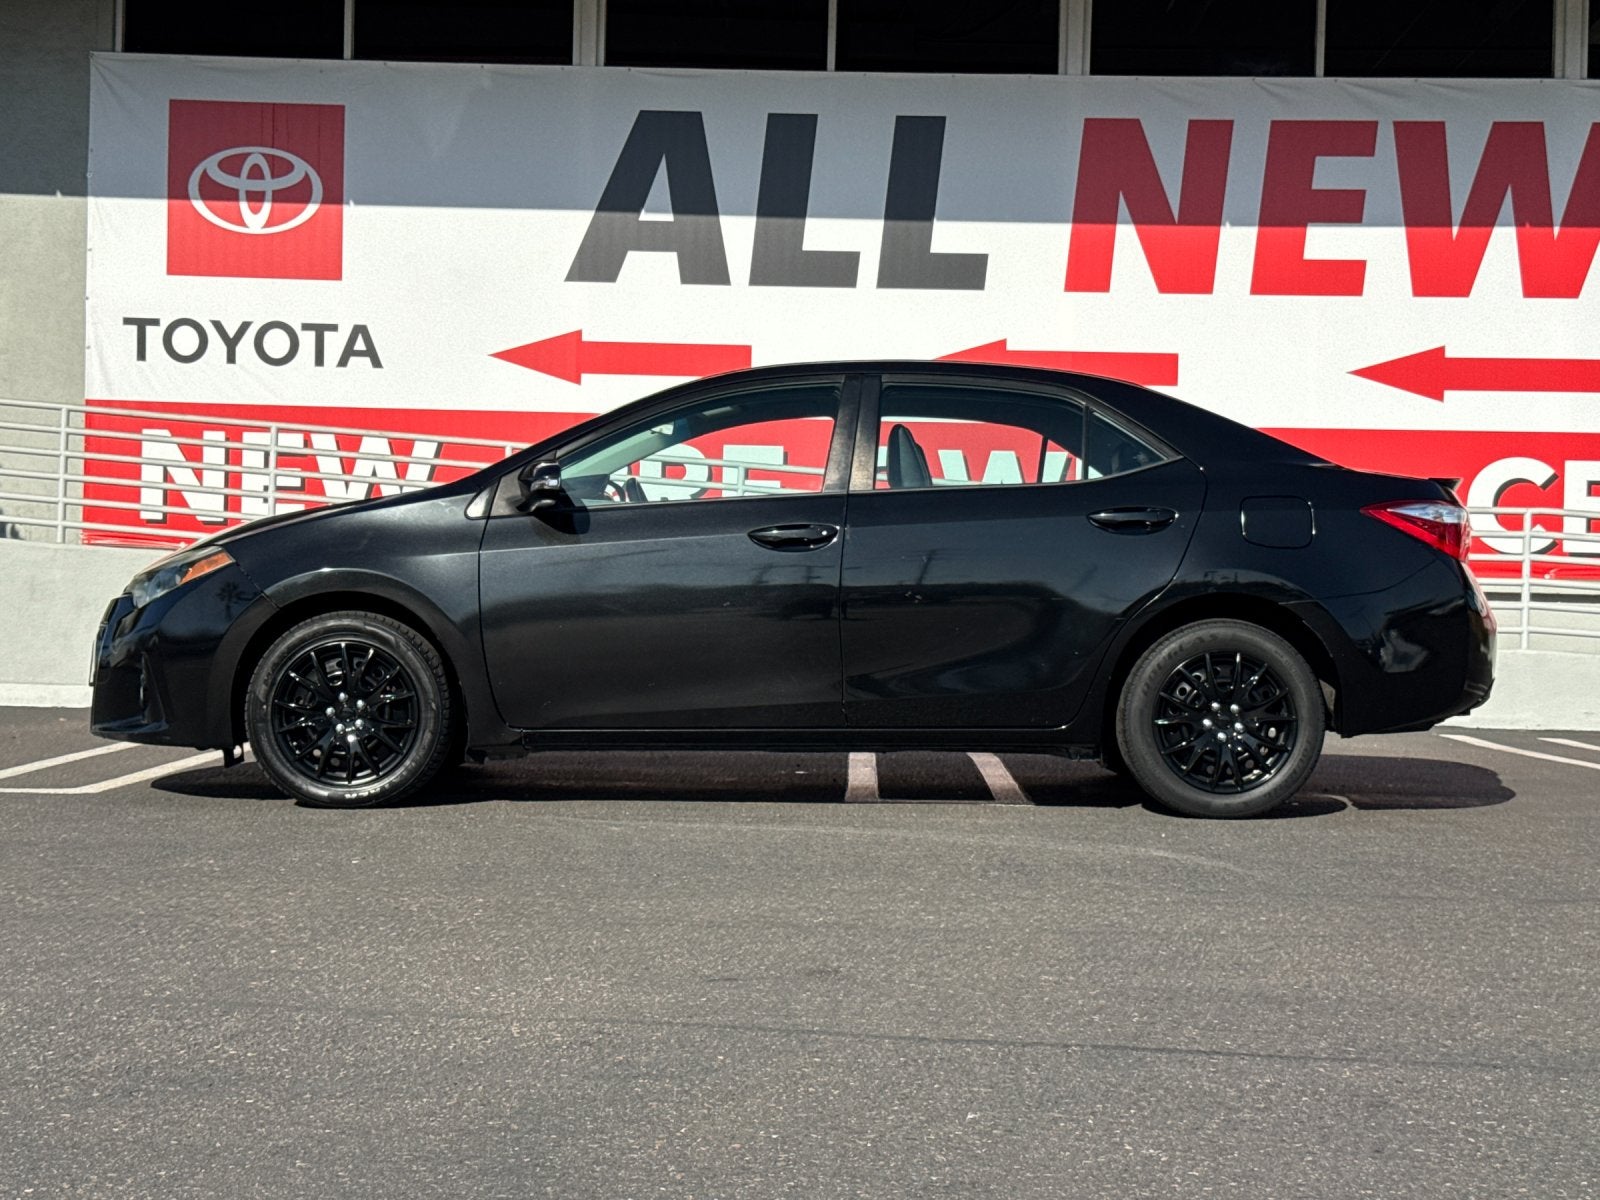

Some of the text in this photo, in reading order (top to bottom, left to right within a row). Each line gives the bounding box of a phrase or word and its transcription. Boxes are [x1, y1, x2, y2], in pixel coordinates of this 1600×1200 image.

[566, 110, 1600, 299] ALL NEW
[122, 317, 383, 369] TOYOTA
[140, 428, 440, 522] NEW
